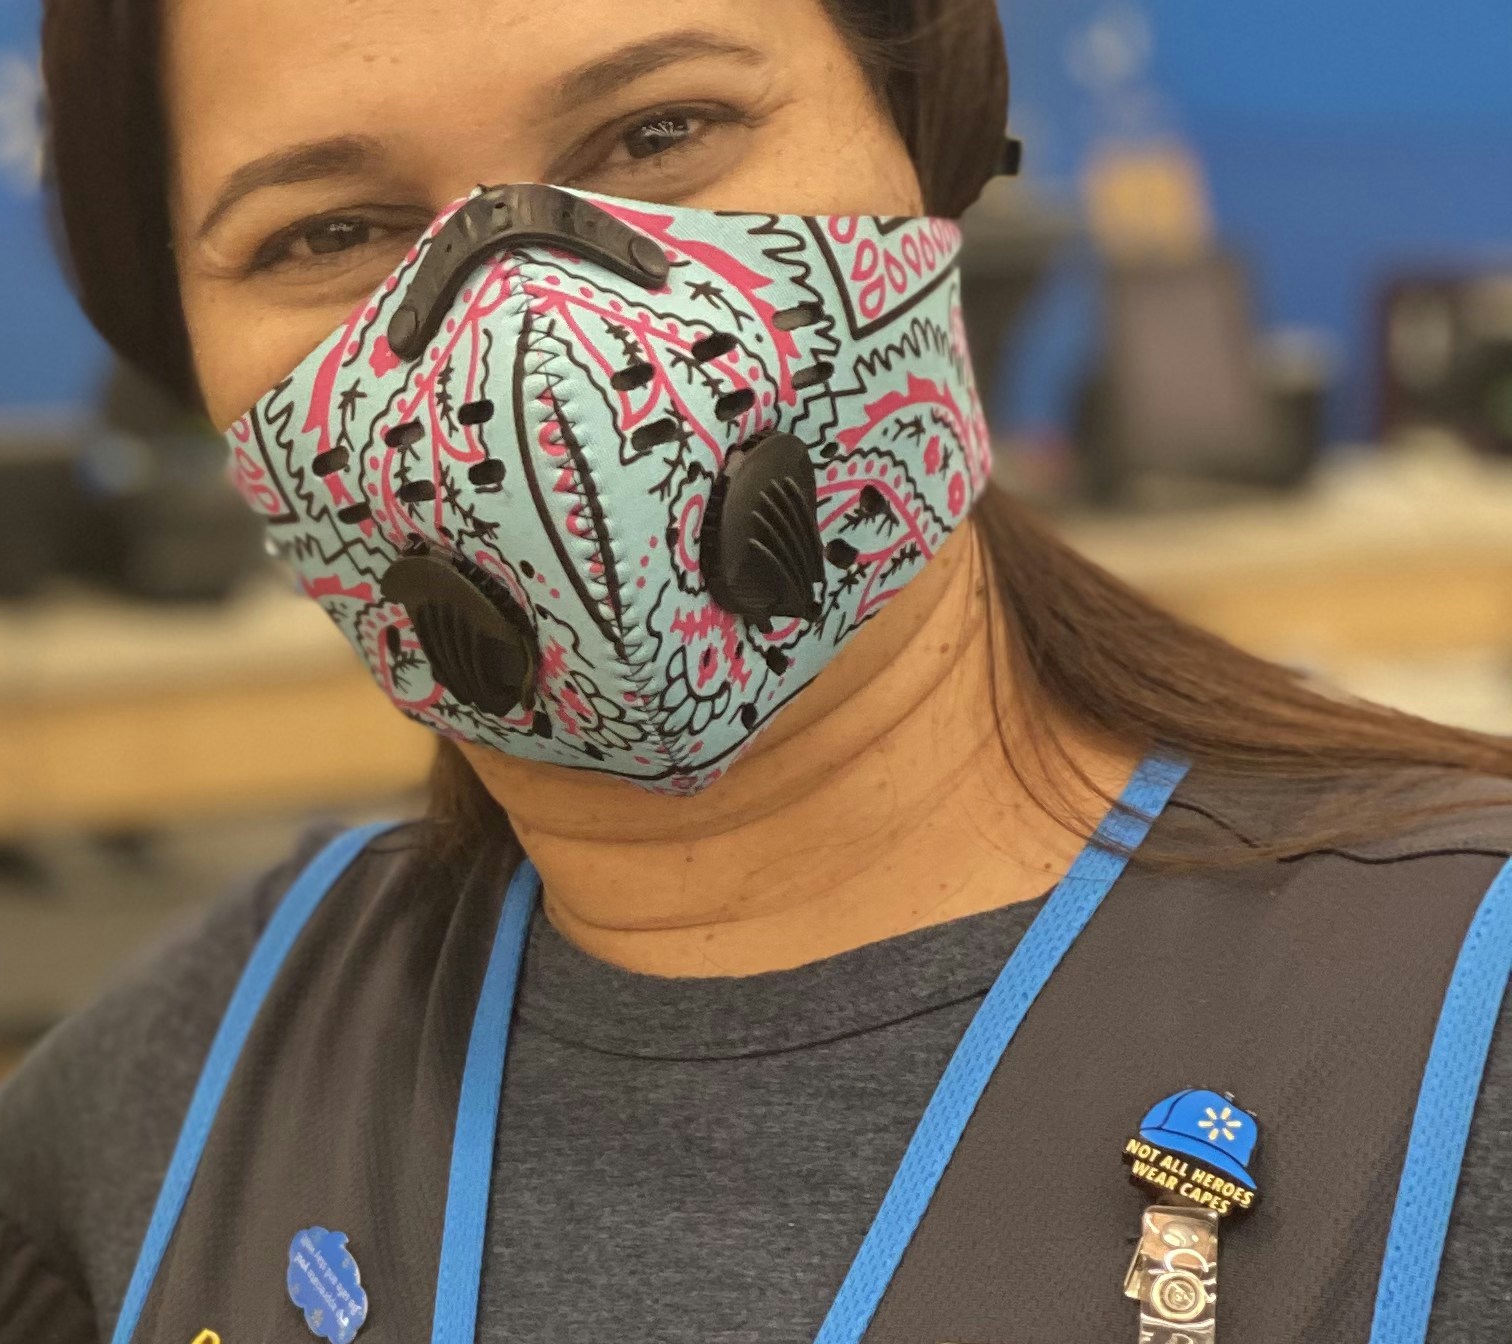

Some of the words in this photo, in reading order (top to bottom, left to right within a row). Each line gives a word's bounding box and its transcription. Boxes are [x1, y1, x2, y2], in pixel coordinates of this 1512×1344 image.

[1126, 1138, 1161, 1163] NOT
[1160, 1155, 1189, 1177] ALL
[1191, 1167, 1255, 1206] HEROES
[1132, 1159, 1179, 1191] WEAR
[1179, 1182, 1232, 1214] CAPES
